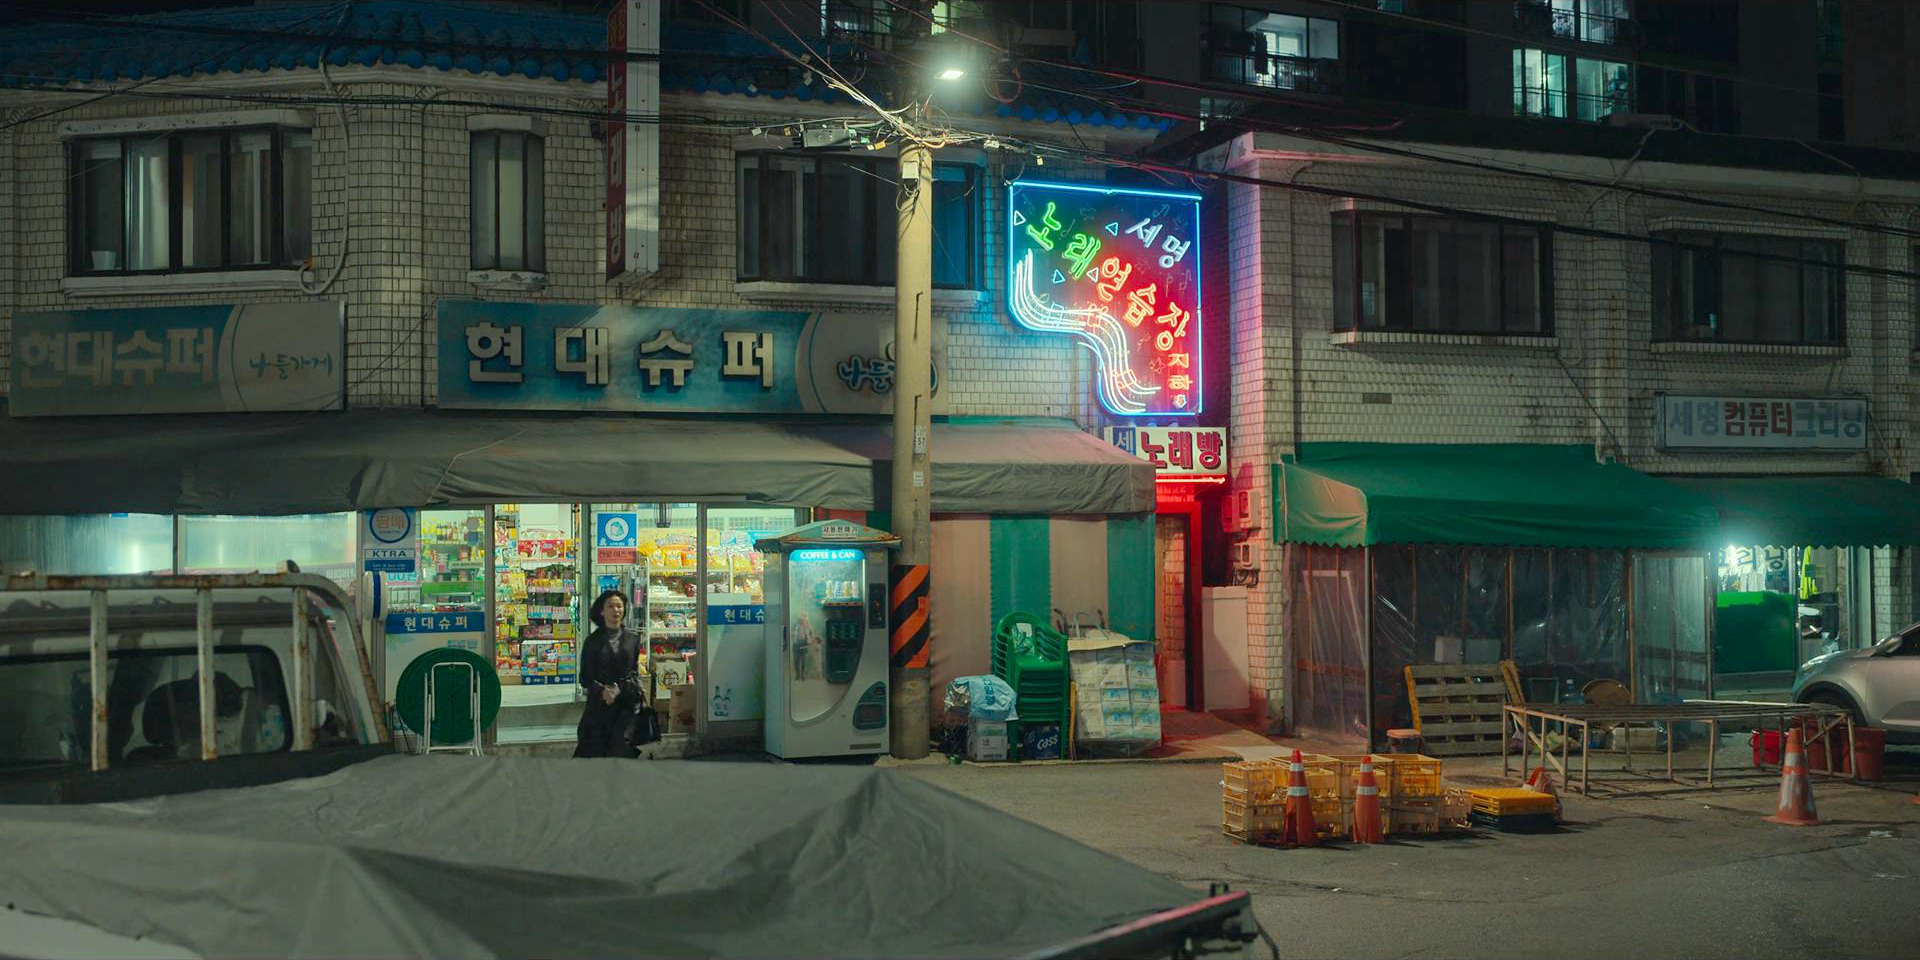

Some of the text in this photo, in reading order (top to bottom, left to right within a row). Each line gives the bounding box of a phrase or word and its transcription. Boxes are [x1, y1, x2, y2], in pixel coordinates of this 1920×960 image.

[1125, 217, 1190, 268] 세명
[19, 327, 333, 388] 현대슈퍼 나들가게
[464, 321, 774, 388] 현대슈퍼
[1669, 400, 1863, 438] 세명 컴퓨터 크리닝
[1140, 431, 1223, 469] 노래방
[799, 550, 856, 560] COFFEE & CAN
[404, 615, 468, 632] 현대슈퍼
